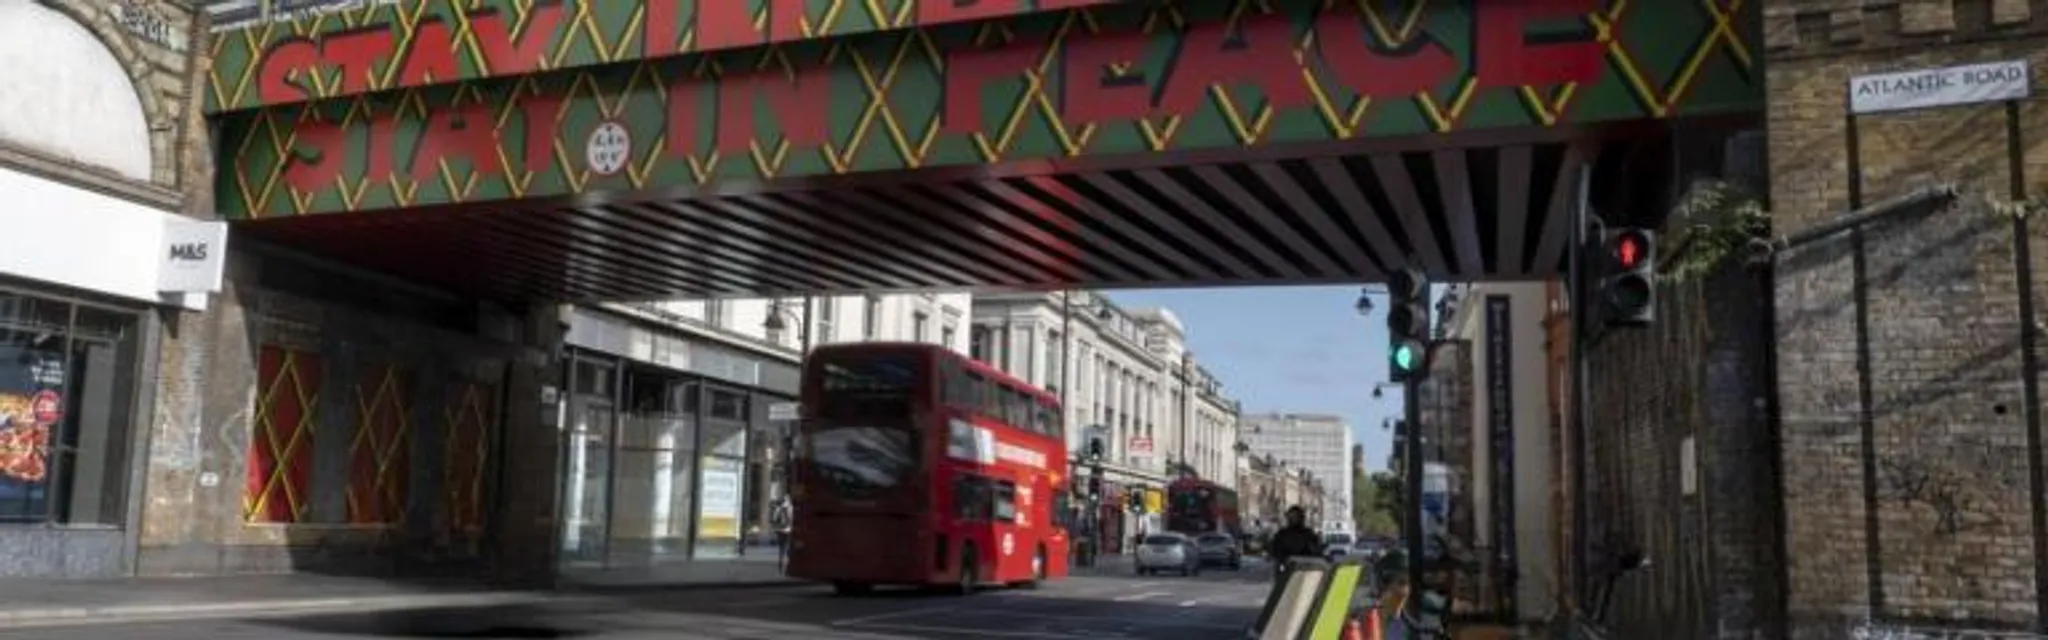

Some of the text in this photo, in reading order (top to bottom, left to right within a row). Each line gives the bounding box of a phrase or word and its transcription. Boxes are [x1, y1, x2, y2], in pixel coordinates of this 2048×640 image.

[1858, 67, 2022, 95] ATLANTIC ROAD
[169, 243, 207, 261] M&S
